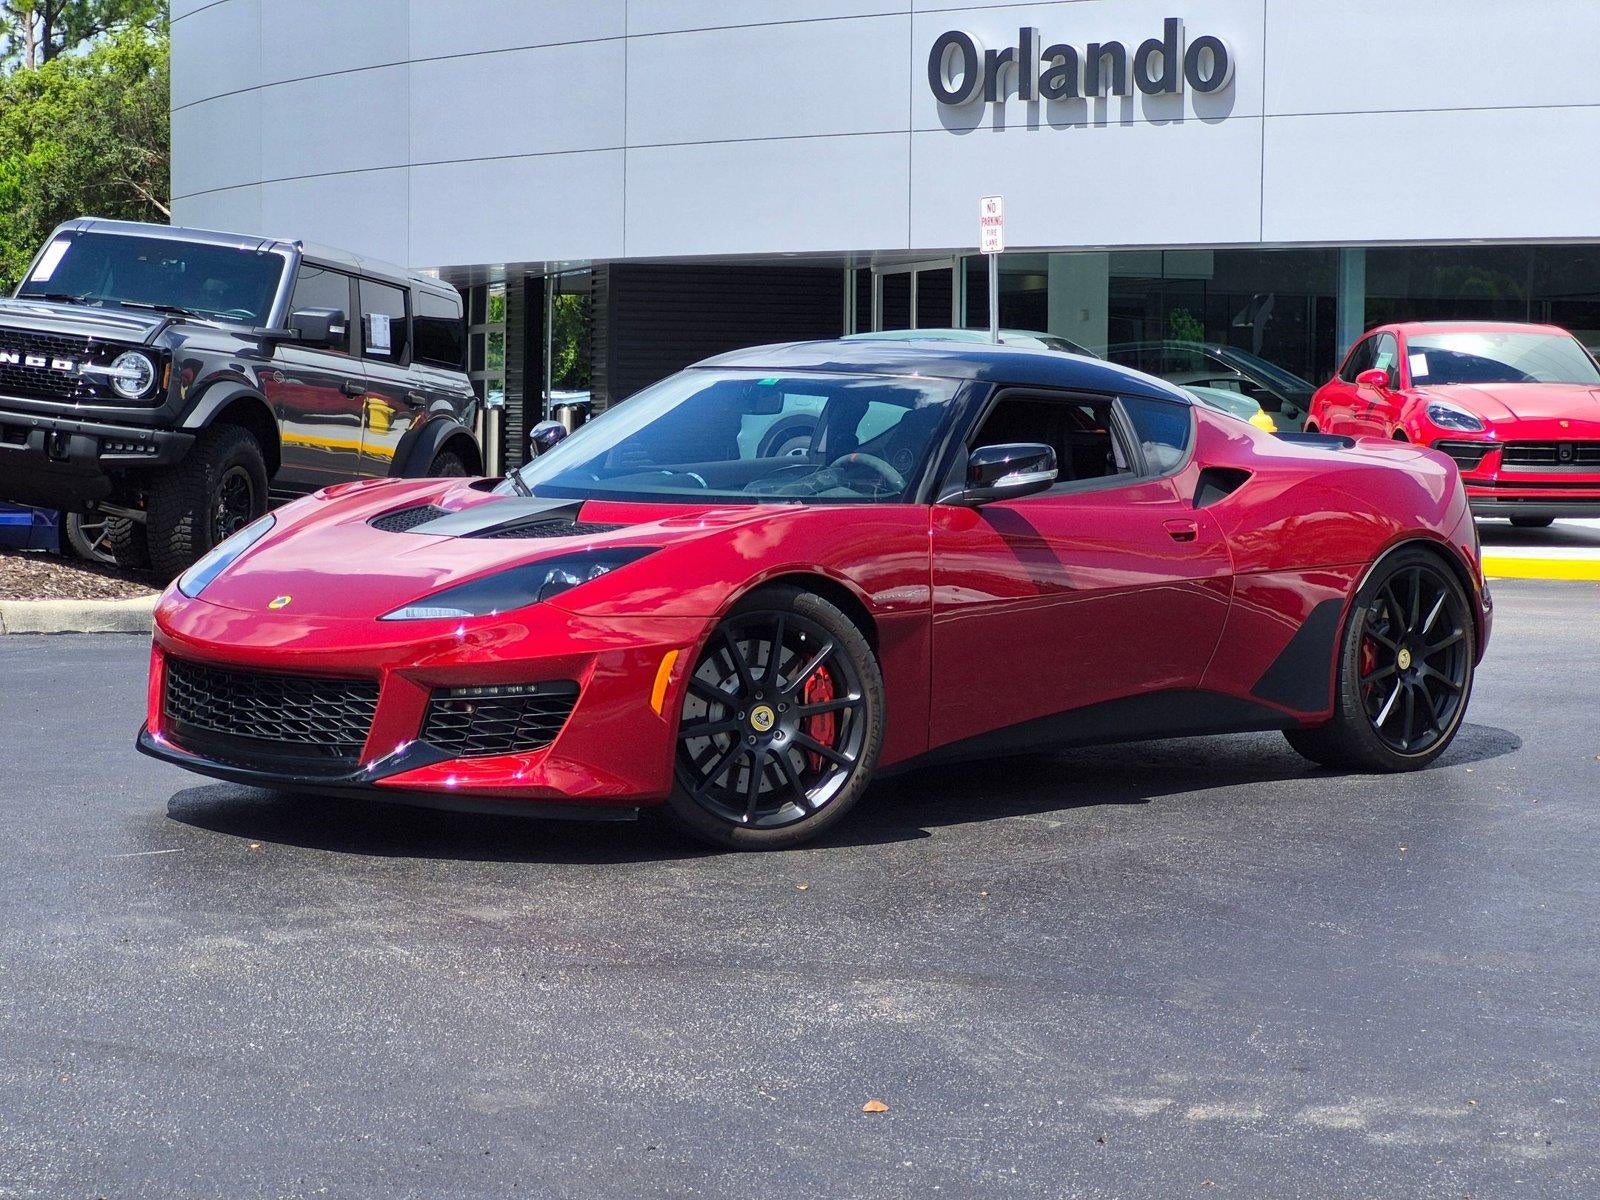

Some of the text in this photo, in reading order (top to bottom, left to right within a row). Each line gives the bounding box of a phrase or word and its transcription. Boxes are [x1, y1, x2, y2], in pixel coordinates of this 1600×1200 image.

[927, 17, 1232, 105] Orlando
[986, 203, 996, 214] NO
[981, 216, 1003, 227] PARKING
[986, 229, 997, 237] FIRE
[985, 238, 998, 247] LANE
